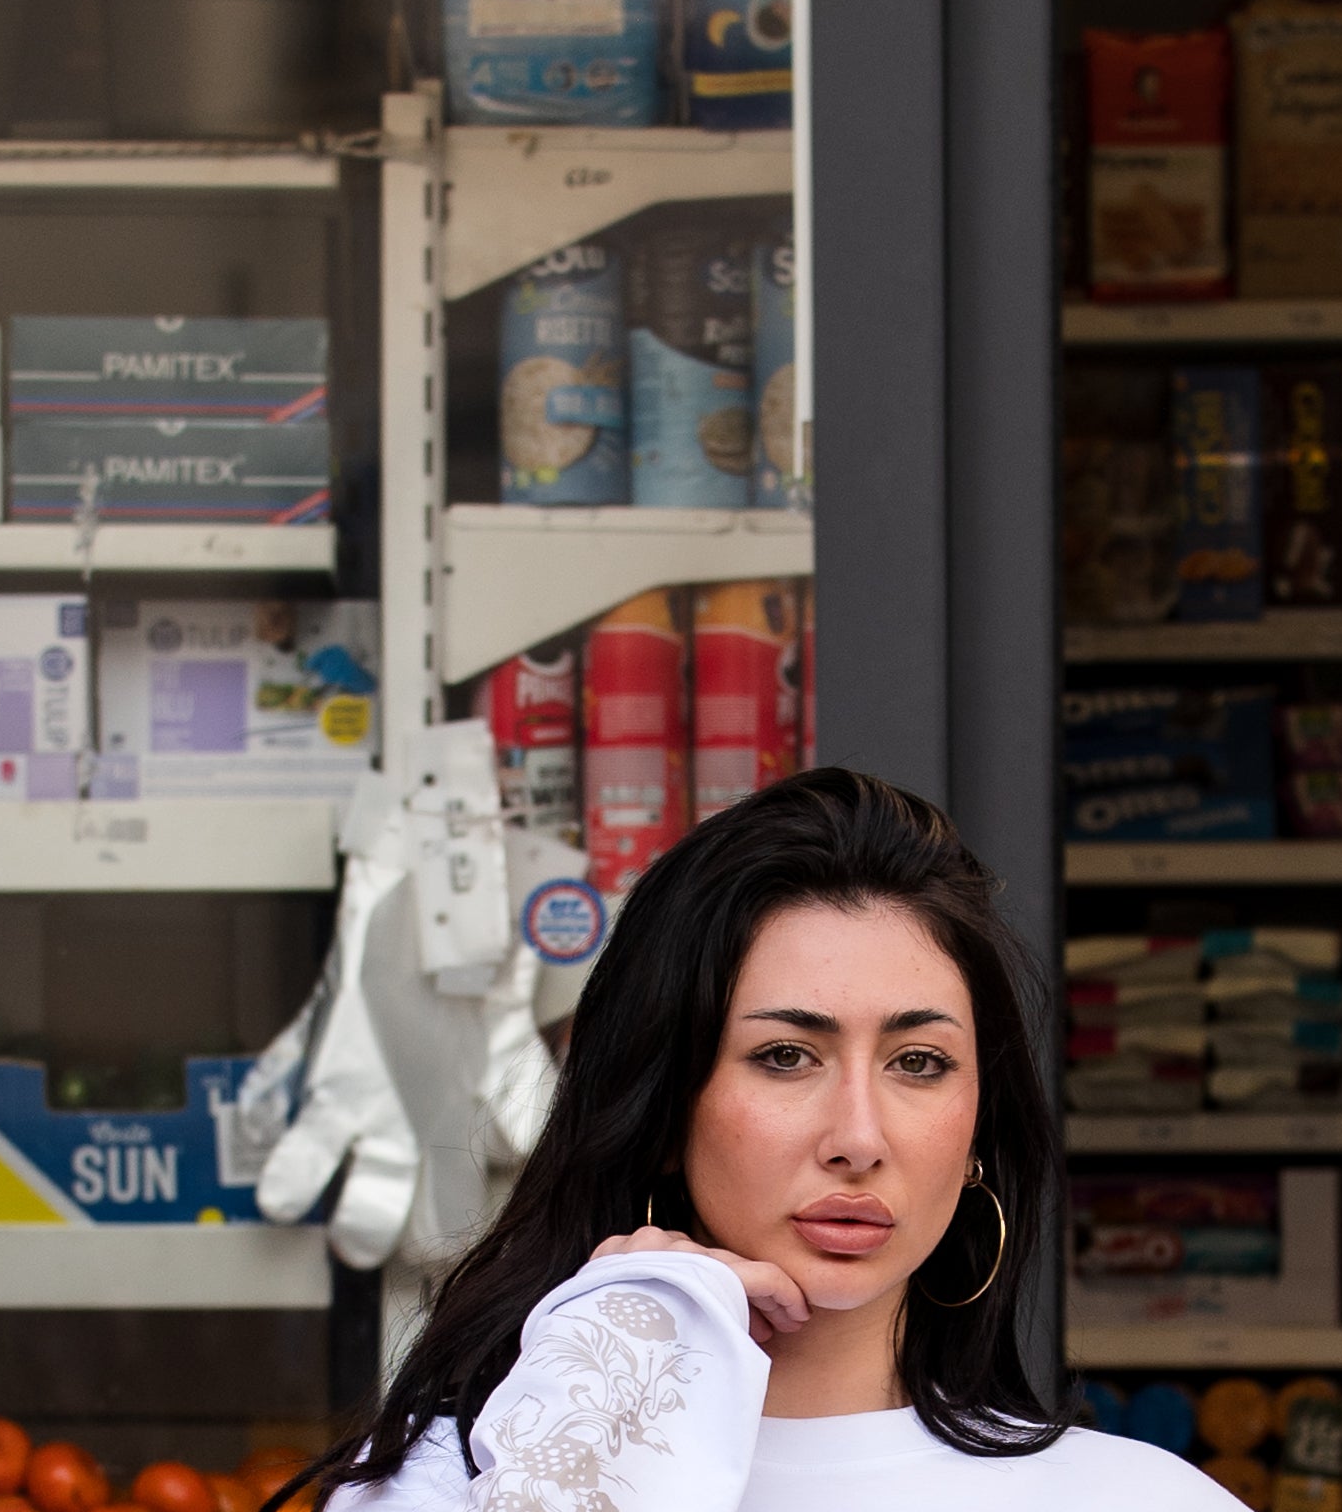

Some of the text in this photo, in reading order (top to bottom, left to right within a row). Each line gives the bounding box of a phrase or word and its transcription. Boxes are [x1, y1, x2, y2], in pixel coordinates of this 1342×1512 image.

[102, 352, 236, 381] PAMITEX
[104, 456, 237, 485] PAMITEX
[70, 1144, 178, 1204] SUN
